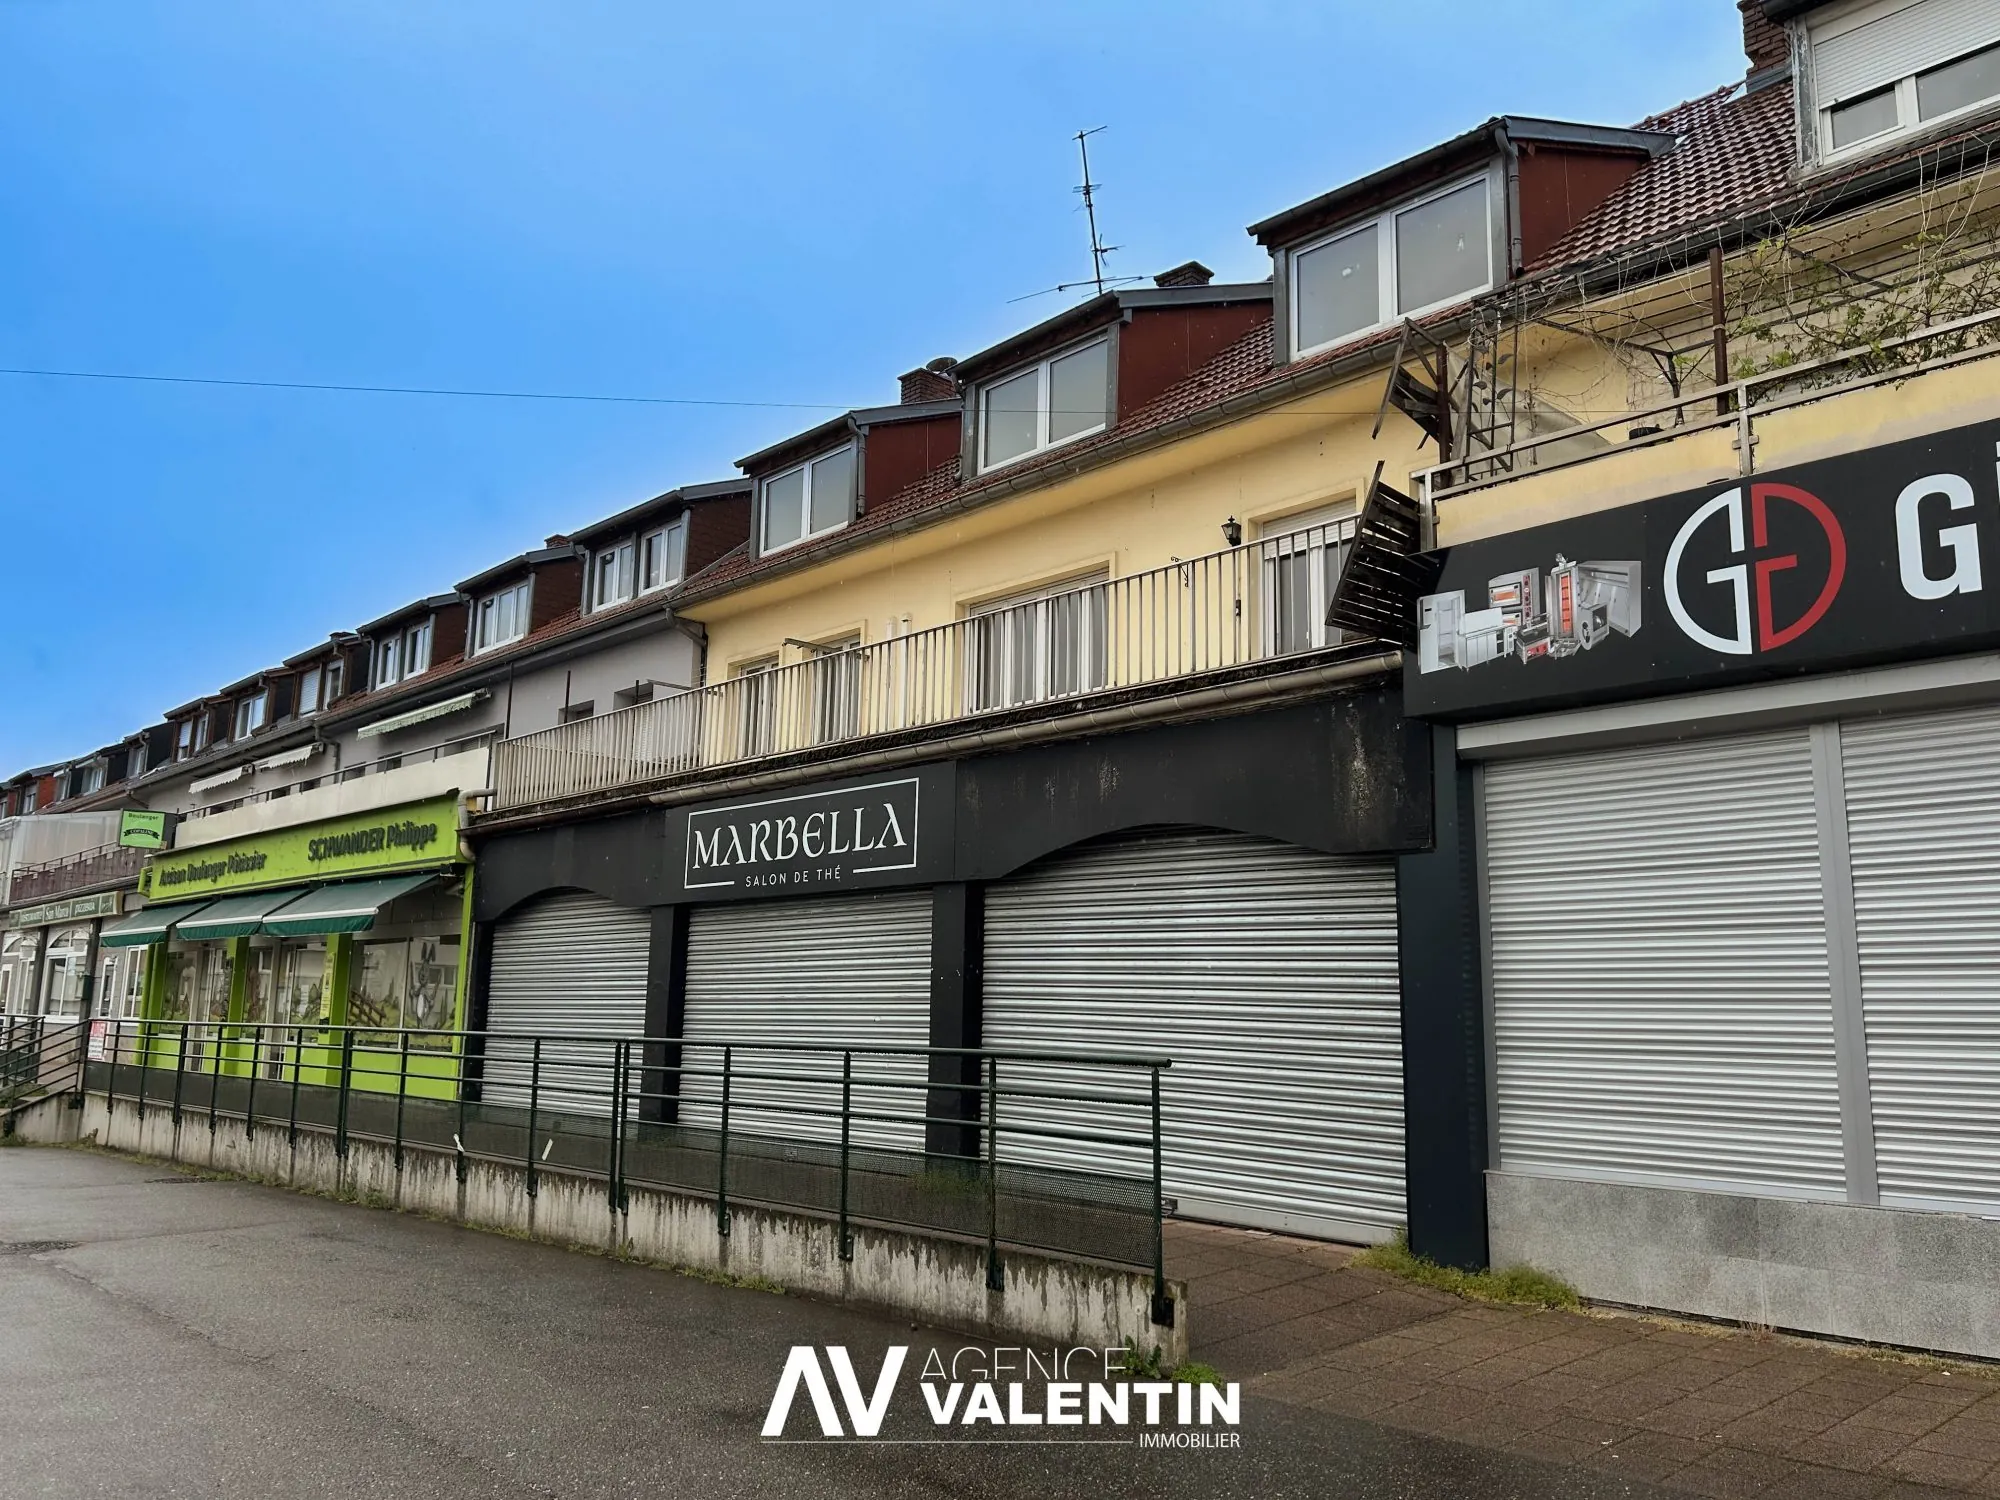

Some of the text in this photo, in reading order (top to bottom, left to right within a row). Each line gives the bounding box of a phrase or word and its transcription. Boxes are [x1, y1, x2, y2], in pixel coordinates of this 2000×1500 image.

[1895, 441, 2000, 600] G
[128, 812, 159, 821] Boulanger
[308, 819, 438, 862] SCHWANDER Philippe
[692, 803, 908, 870] MARBELLA
[187, 859, 228, 884] Boulanger
[744, 864, 842, 888] SALON DE THÉ
